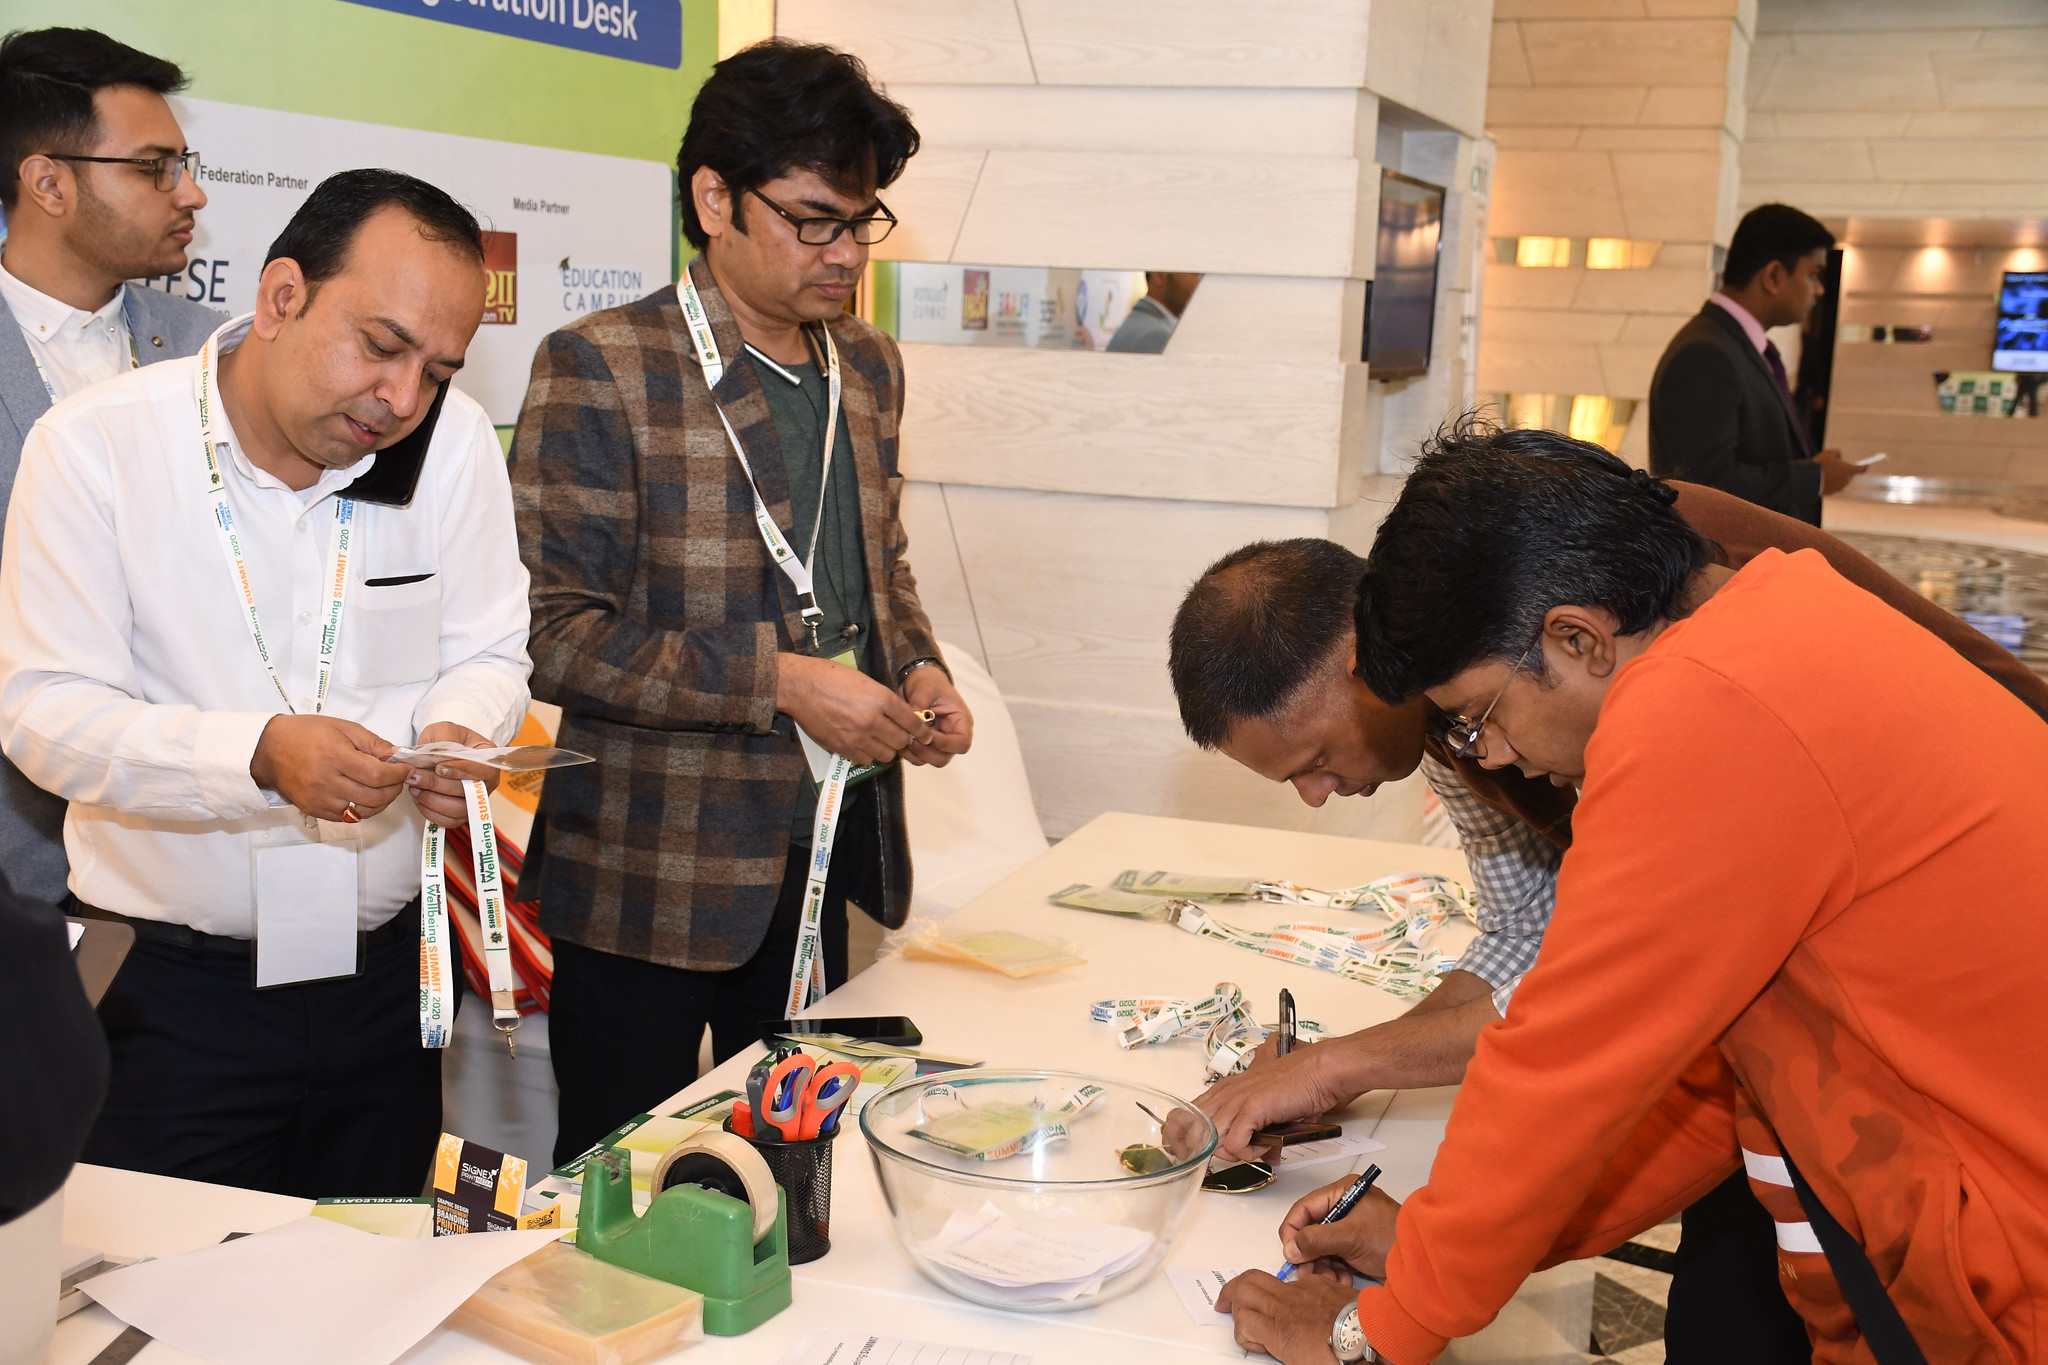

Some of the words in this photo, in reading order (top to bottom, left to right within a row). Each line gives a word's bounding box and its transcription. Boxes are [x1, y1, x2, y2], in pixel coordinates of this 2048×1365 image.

[573, 0, 638, 40] Desk
[201, 165, 264, 186] Federation
[268, 173, 308, 190] Partner
[513, 197, 538, 212] Media
[540, 200, 570, 214] Partner
[562, 267, 642, 289] EDUCATION
[498, 307, 515, 322] TV
[229, 534, 241, 557] 2020
[339, 529, 349, 551] 2020
[236, 559, 254, 605] SUMMIT
[333, 553, 348, 598] SUMMIT
[323, 600, 342, 655] Wellbeing
[472, 780, 489, 821] SUMM
[822, 782, 839, 822] SUMMIT
[820, 824, 829, 843] 2020
[483, 823, 495, 883] Wellbeing
[427, 884, 437, 944] Wellbeing
[486, 898, 496, 929] SHOBHIT
[795, 934, 811, 979] Wellbeing
[1265, 948, 1295, 959] SUMMIT
[429, 946, 441, 994] SUMMIT
[432, 997, 441, 1020] 2020
[789, 979, 803, 1016] SUMMIT
[1117, 1009, 1134, 1017] 2020
[461, 1162, 494, 1181] SIGNEX
[437, 1197, 454, 1208] GRAPHIC
[454, 1203, 469, 1213] DESIGN
[437, 1209, 469, 1227] BRANDING
[437, 1217, 469, 1234] PRINTING
[527, 1213, 552, 1226] SIGNEX
